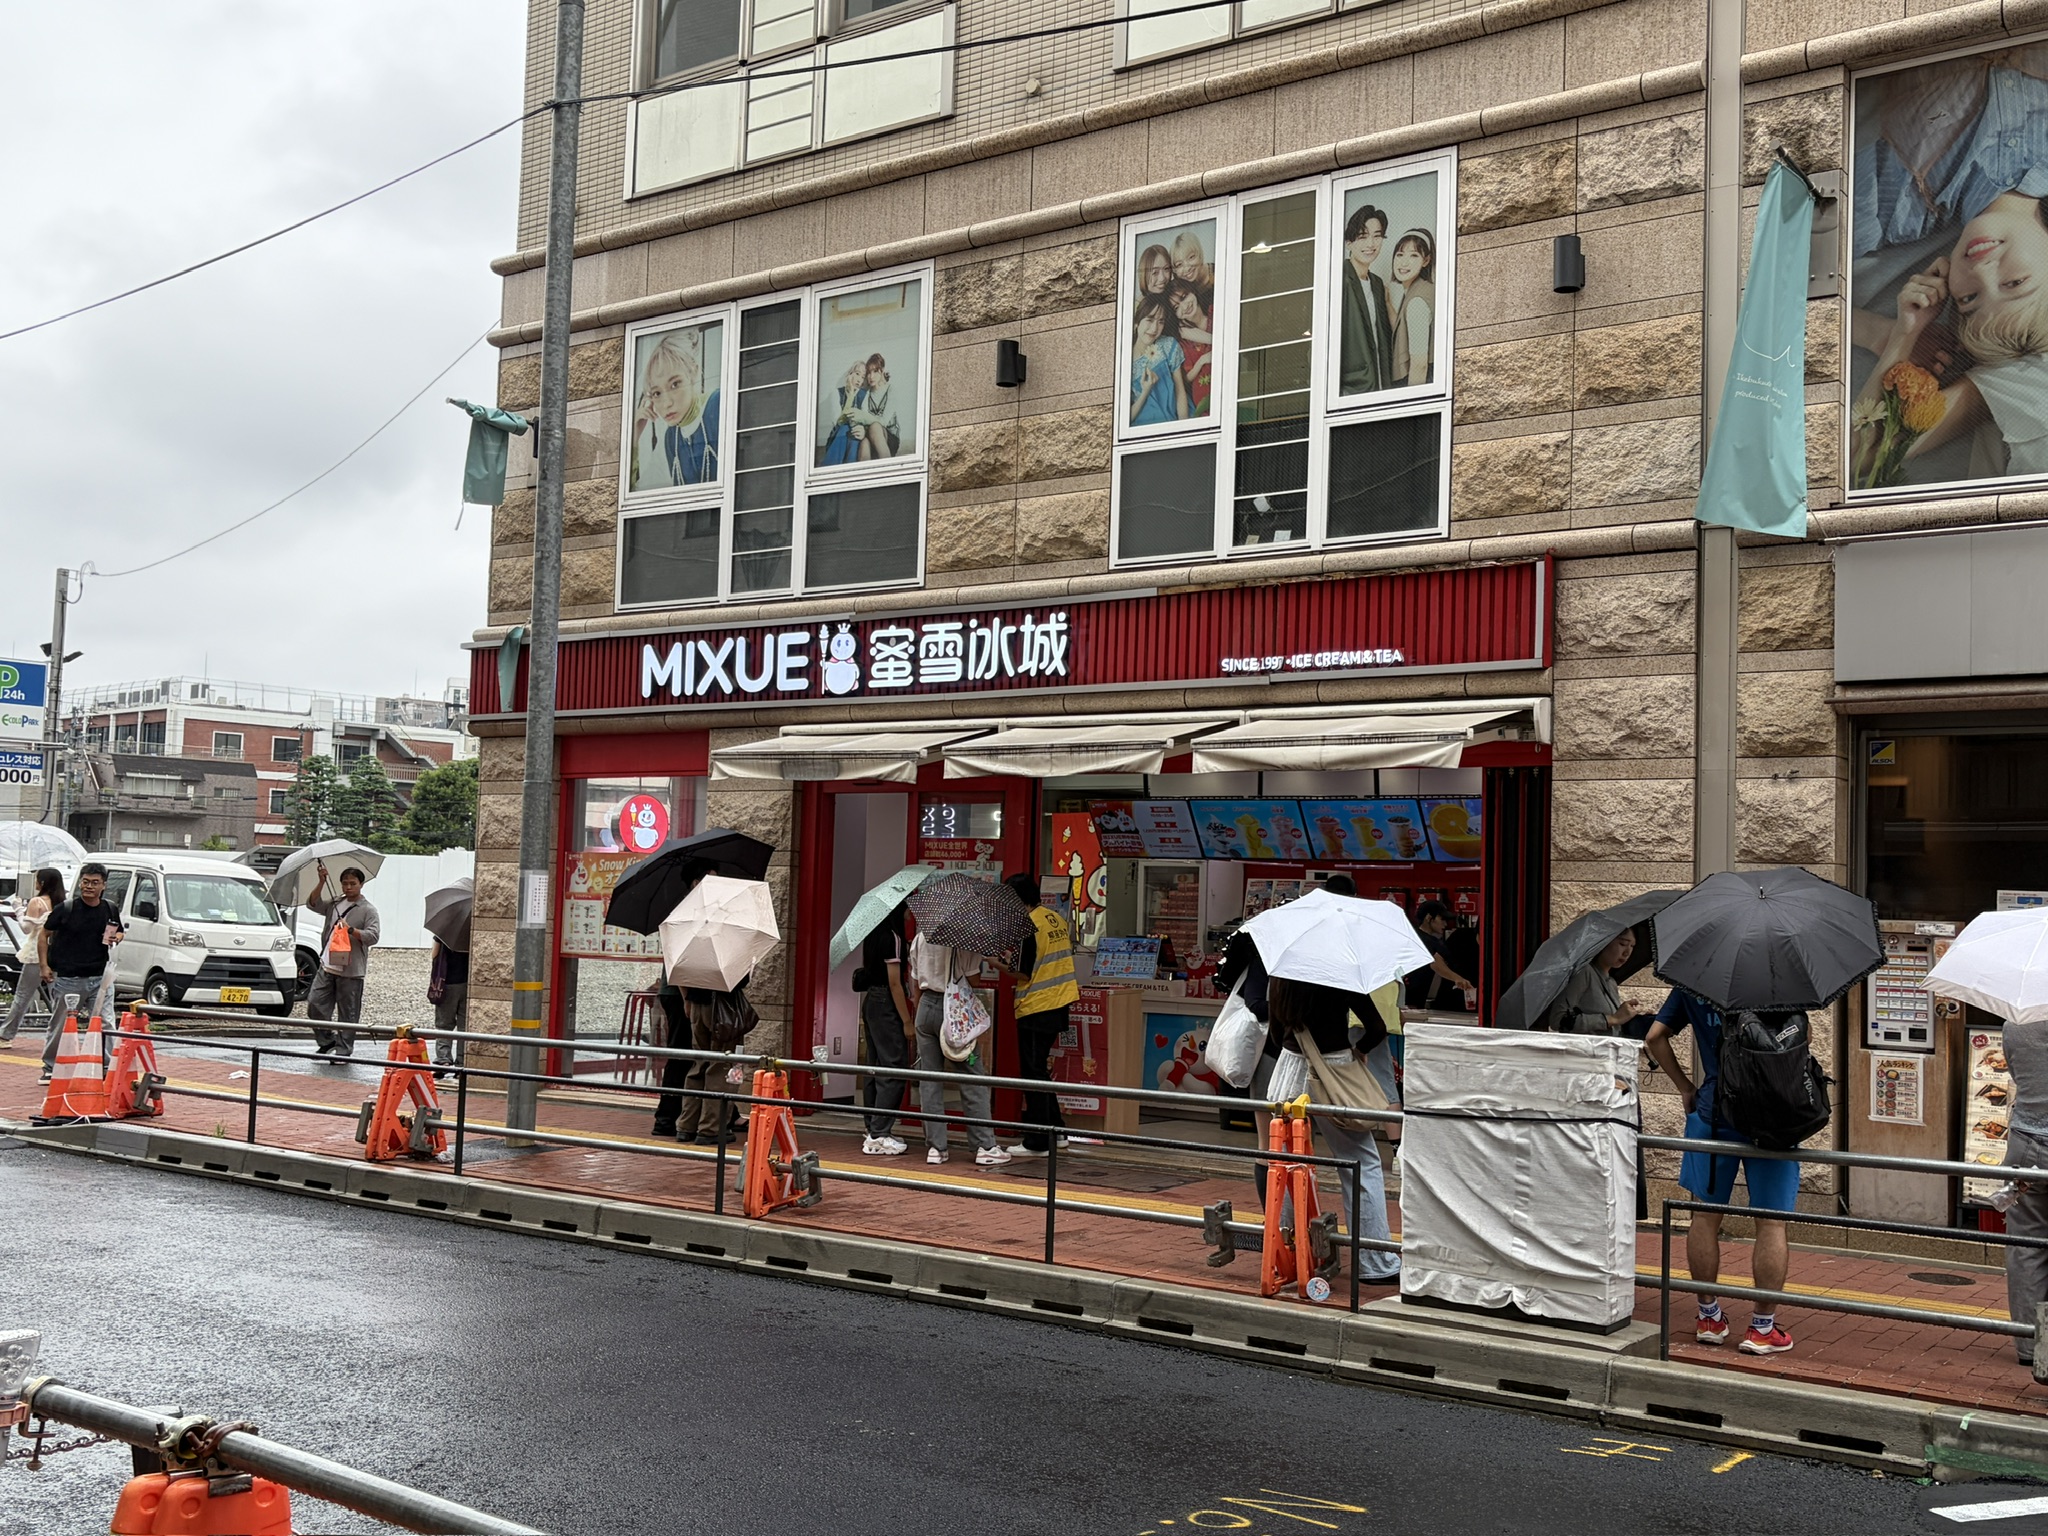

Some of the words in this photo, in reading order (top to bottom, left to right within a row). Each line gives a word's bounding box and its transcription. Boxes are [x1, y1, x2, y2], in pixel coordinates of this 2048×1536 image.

[1734, 390, 1769, 402] produced
[868, 612, 1069, 689] 蜜雪冰城
[641, 631, 811, 698] MIXUE
[1221, 657, 1260, 672] SINCE
[1260, 656, 1284, 670] 1997
[3, 689, 26, 701] 24h
[598, 858, 625, 872] Snow
[1080, 990, 1101, 998] MIXUE
[1878, 1059, 1916, 1069] 人気ランキング
